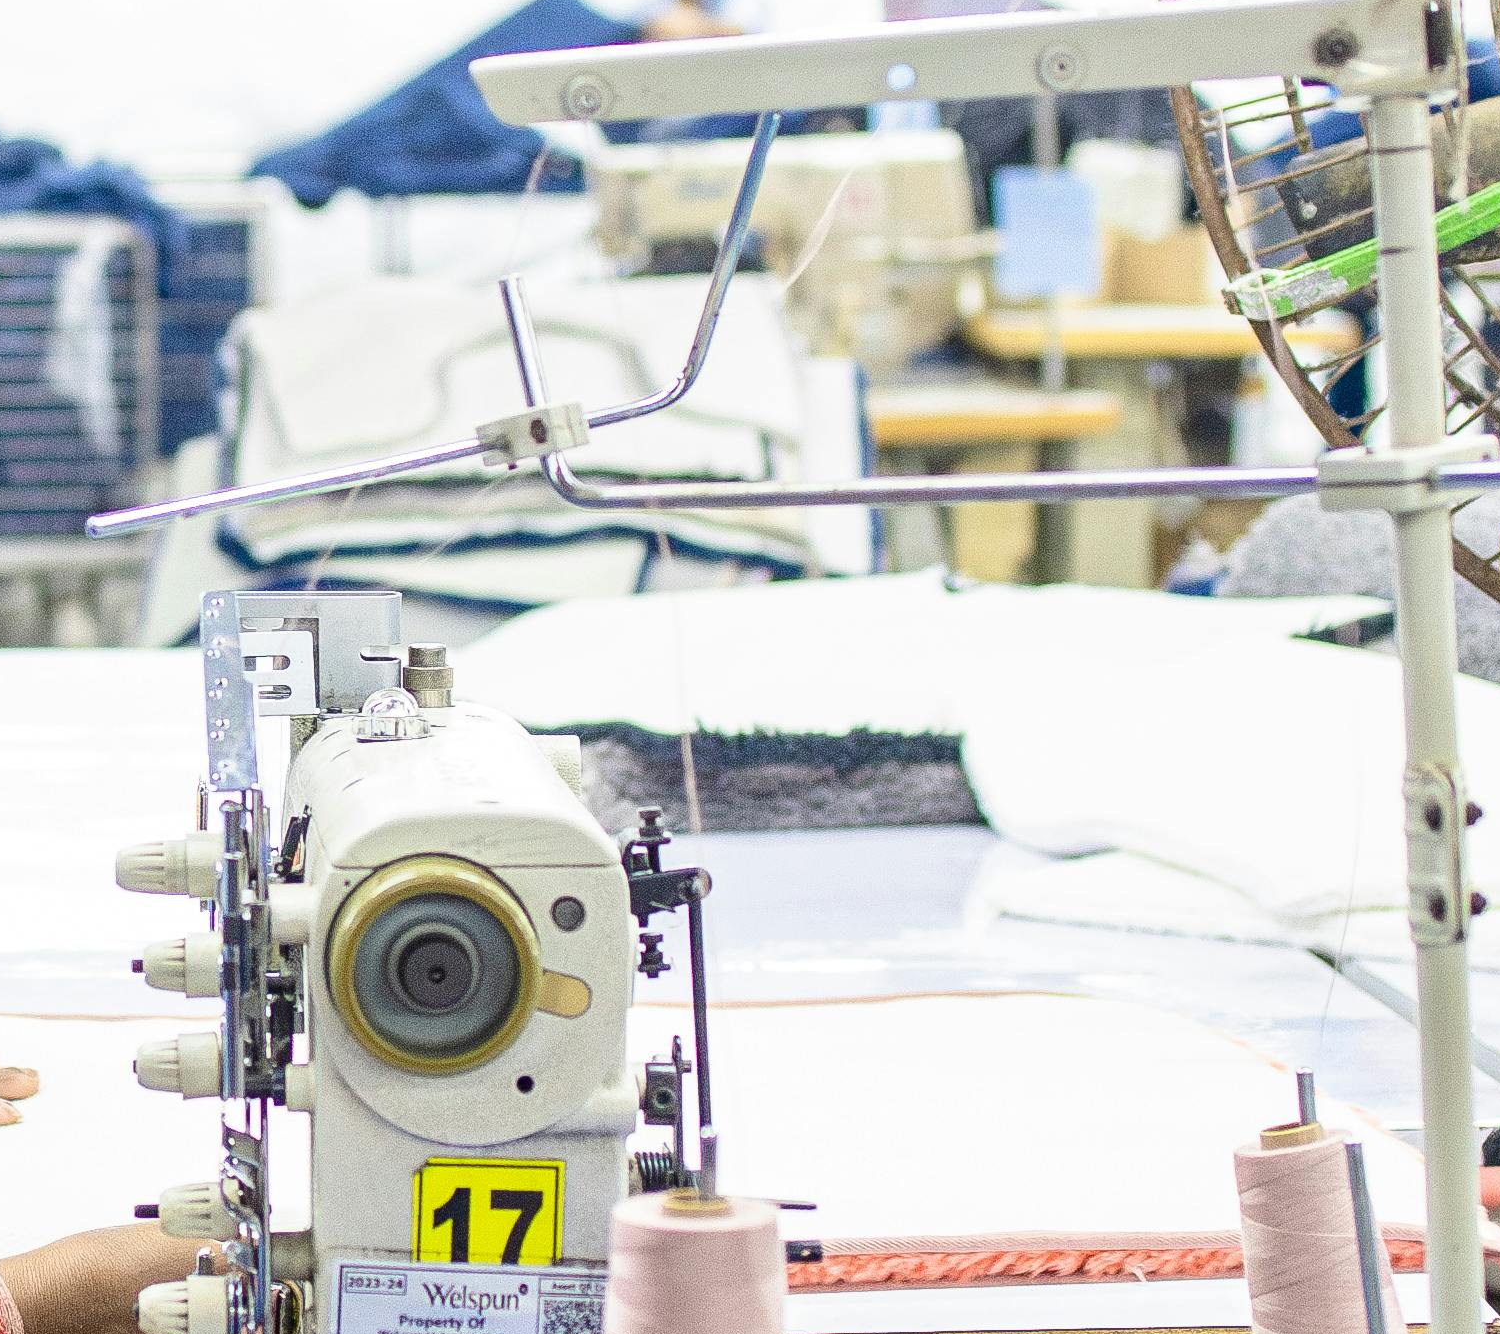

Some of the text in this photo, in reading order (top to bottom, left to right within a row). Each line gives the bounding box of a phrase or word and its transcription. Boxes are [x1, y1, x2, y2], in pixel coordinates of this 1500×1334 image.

[432, 1186, 545, 1264] 17
[420, 1282, 520, 1315] Welspun
[398, 1314, 486, 1332] Property Of
